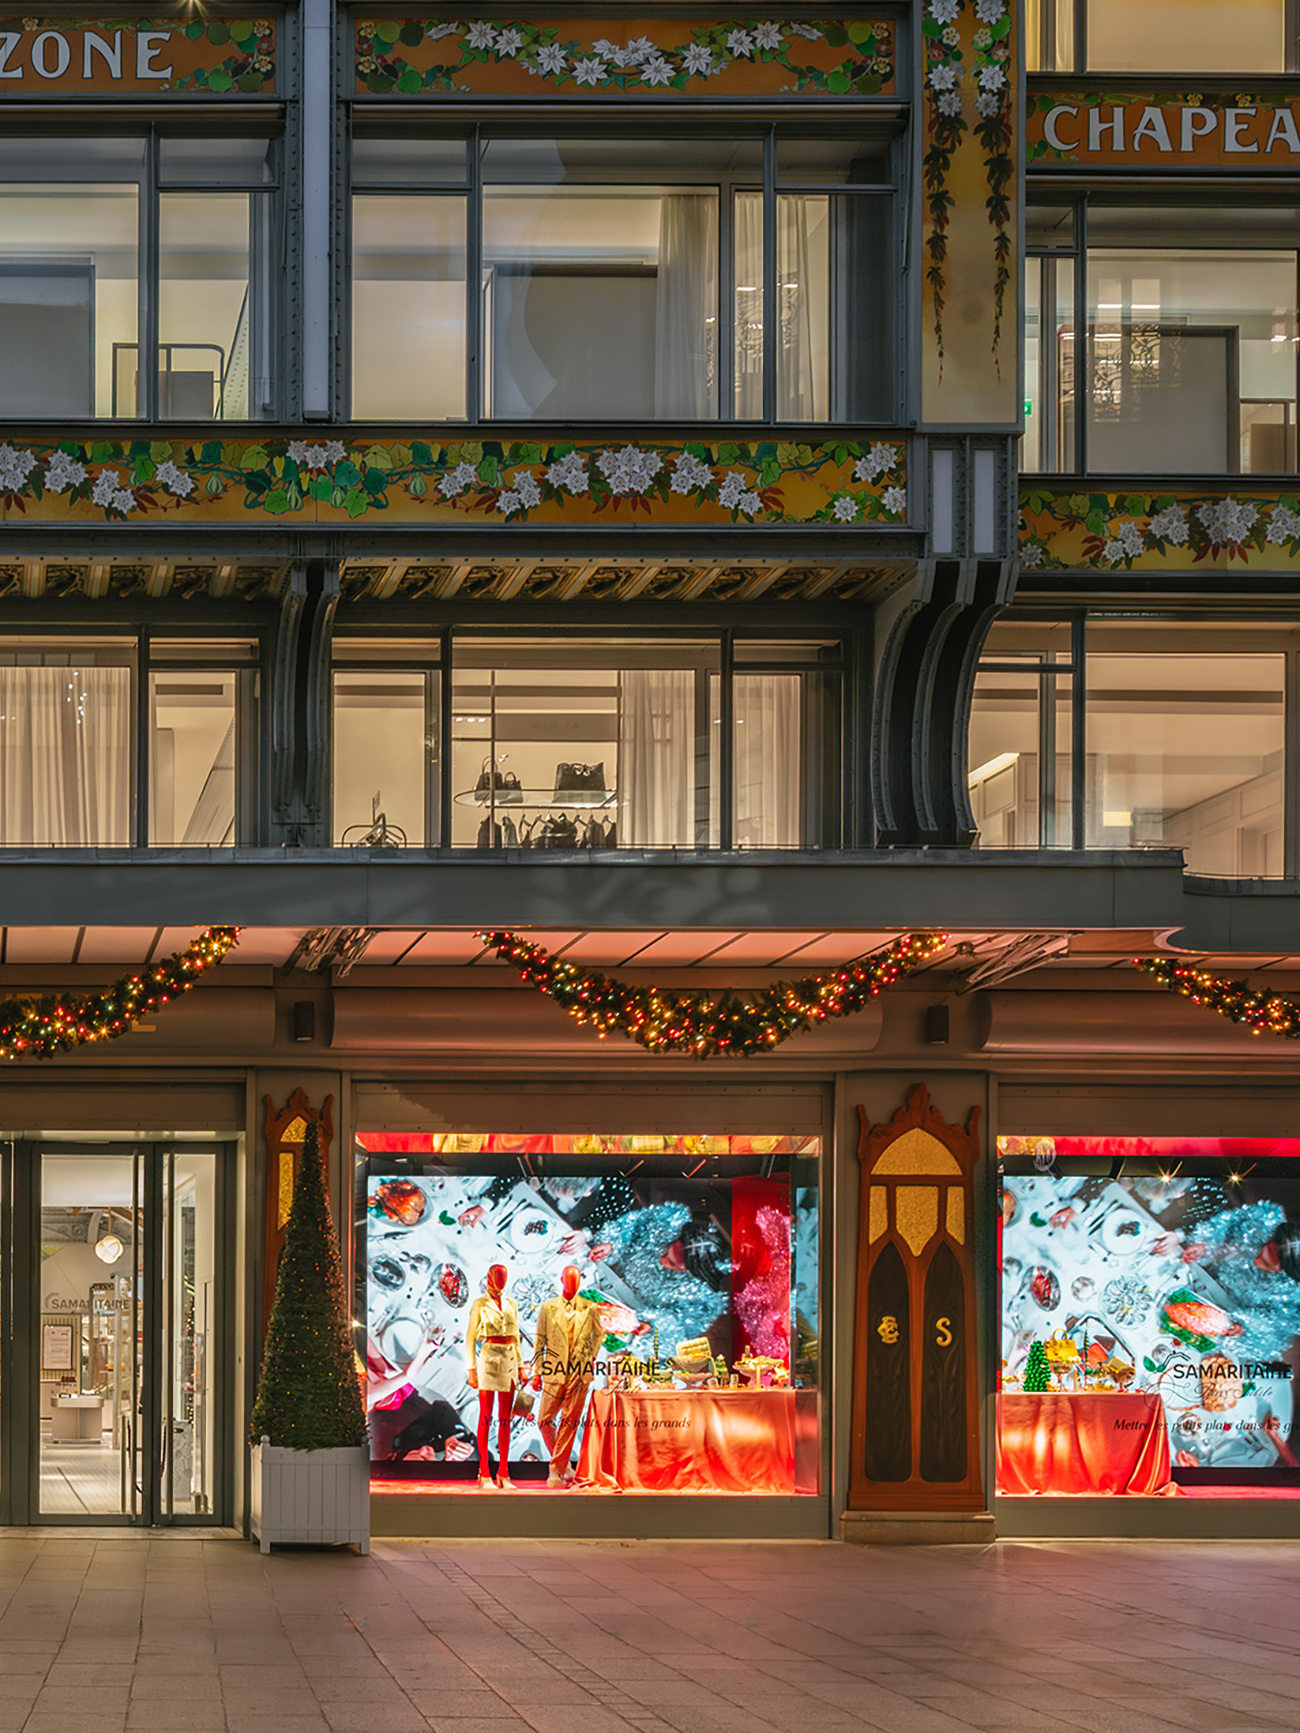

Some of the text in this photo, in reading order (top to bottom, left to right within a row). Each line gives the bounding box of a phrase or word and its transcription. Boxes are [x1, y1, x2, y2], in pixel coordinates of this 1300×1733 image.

[1043, 104, 1300, 153] CHAPEA
[51, 1298, 130, 1310] SAMAITAINE
[935, 1317, 953, 1347] S
[541, 1360, 661, 1377] SAMARITAINE
[1172, 1363, 1293, 1380] SAMARITAINE
[633, 1416, 648, 1428] les
[650, 1416, 692, 1431] grands
[1113, 1419, 1151, 1431] Mettre
[1235, 1419, 1262, 1431] dans
